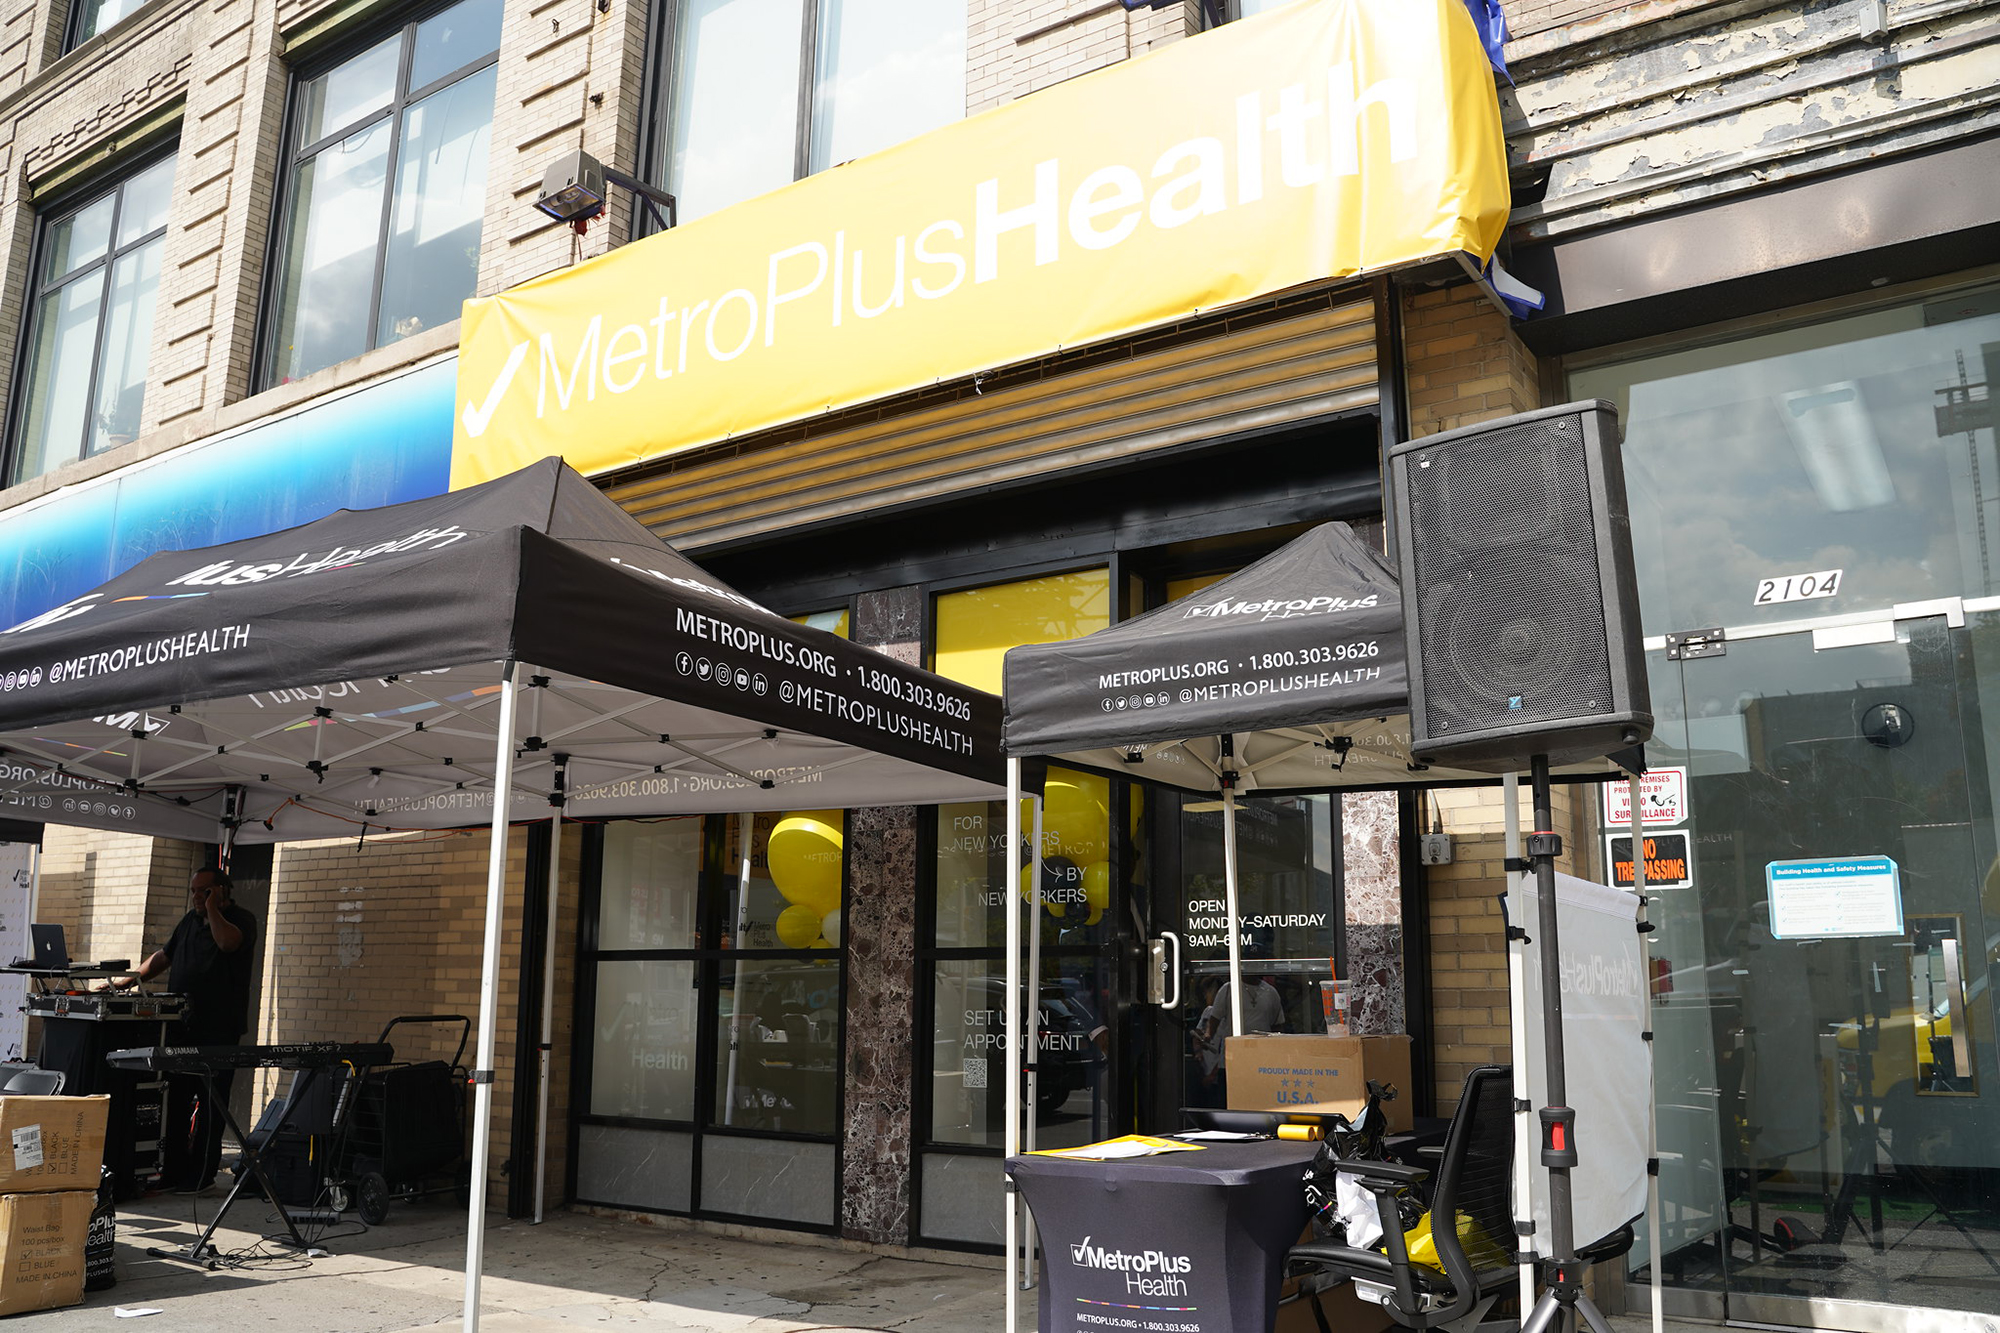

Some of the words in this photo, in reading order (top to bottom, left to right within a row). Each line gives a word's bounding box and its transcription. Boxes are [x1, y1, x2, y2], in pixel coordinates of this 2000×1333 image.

[536, 61, 1418, 418] MetroPlusHealth
[1759, 573, 1837, 602] 2104
[1210, 595, 1378, 617] MetroPlus
[50, 624, 250, 683] @METROPLUSHEALTH
[676, 607, 837, 678] METROPLUS.ORG
[858, 665, 971, 721] 1.800.303.9626
[1099, 659, 1230, 689] METROPLUS.ORG
[1249, 641, 1379, 671] 1.800.303.9626
[1179, 667, 1380, 703] @METROPLUSHEALTH
[779, 680, 973, 756] @METROPLUSHEALTH
[1638, 775, 1670, 783] REMISES
[1622, 797, 1646, 806] VIO
[954, 816, 983, 830] FOR
[1615, 808, 1676, 819] SURILLANCE
[954, 836, 986, 850] NEW
[990, 831, 1060, 848] YOKRS
[1066, 867, 1087, 881] BY
[1615, 859, 1685, 881] TREPASSING
[1188, 899, 1226, 912] OPEN
[1188, 913, 1326, 930] MONDY–SATURDAY
[1188, 934, 1252, 947] 9AM–6M
[964, 1010, 994, 1025] SET
[173, 1047, 199, 1055] YAMAHA
[631, 1047, 688, 1071] Health
[1258, 1067, 1290, 1075] PROUDLY
[1292, 1068, 1313, 1076] MADE
[1277, 1091, 1319, 1104] U.S.A.
[74, 1111, 84, 1137] CHINA
[49, 1131, 60, 1159] BLACK
[61, 1137, 70, 1159] BLUE
[73, 1139, 80, 1148] IN
[70, 1151, 79, 1175] MADE
[37, 1237, 65, 1245] pcs/box
[36, 1248, 62, 1256] BLACK
[1086, 1246, 1191, 1273] MetroPlus
[34, 1261, 55, 1269] BLUE
[16, 1274, 40, 1283] MADE
[53, 1270, 77, 1279] CHINA
[1126, 1272, 1188, 1296] Health
[1076, 1313, 1137, 1329] METROPLUS.ORG
[1143, 1321, 1200, 1332] 1.800.303.9626
